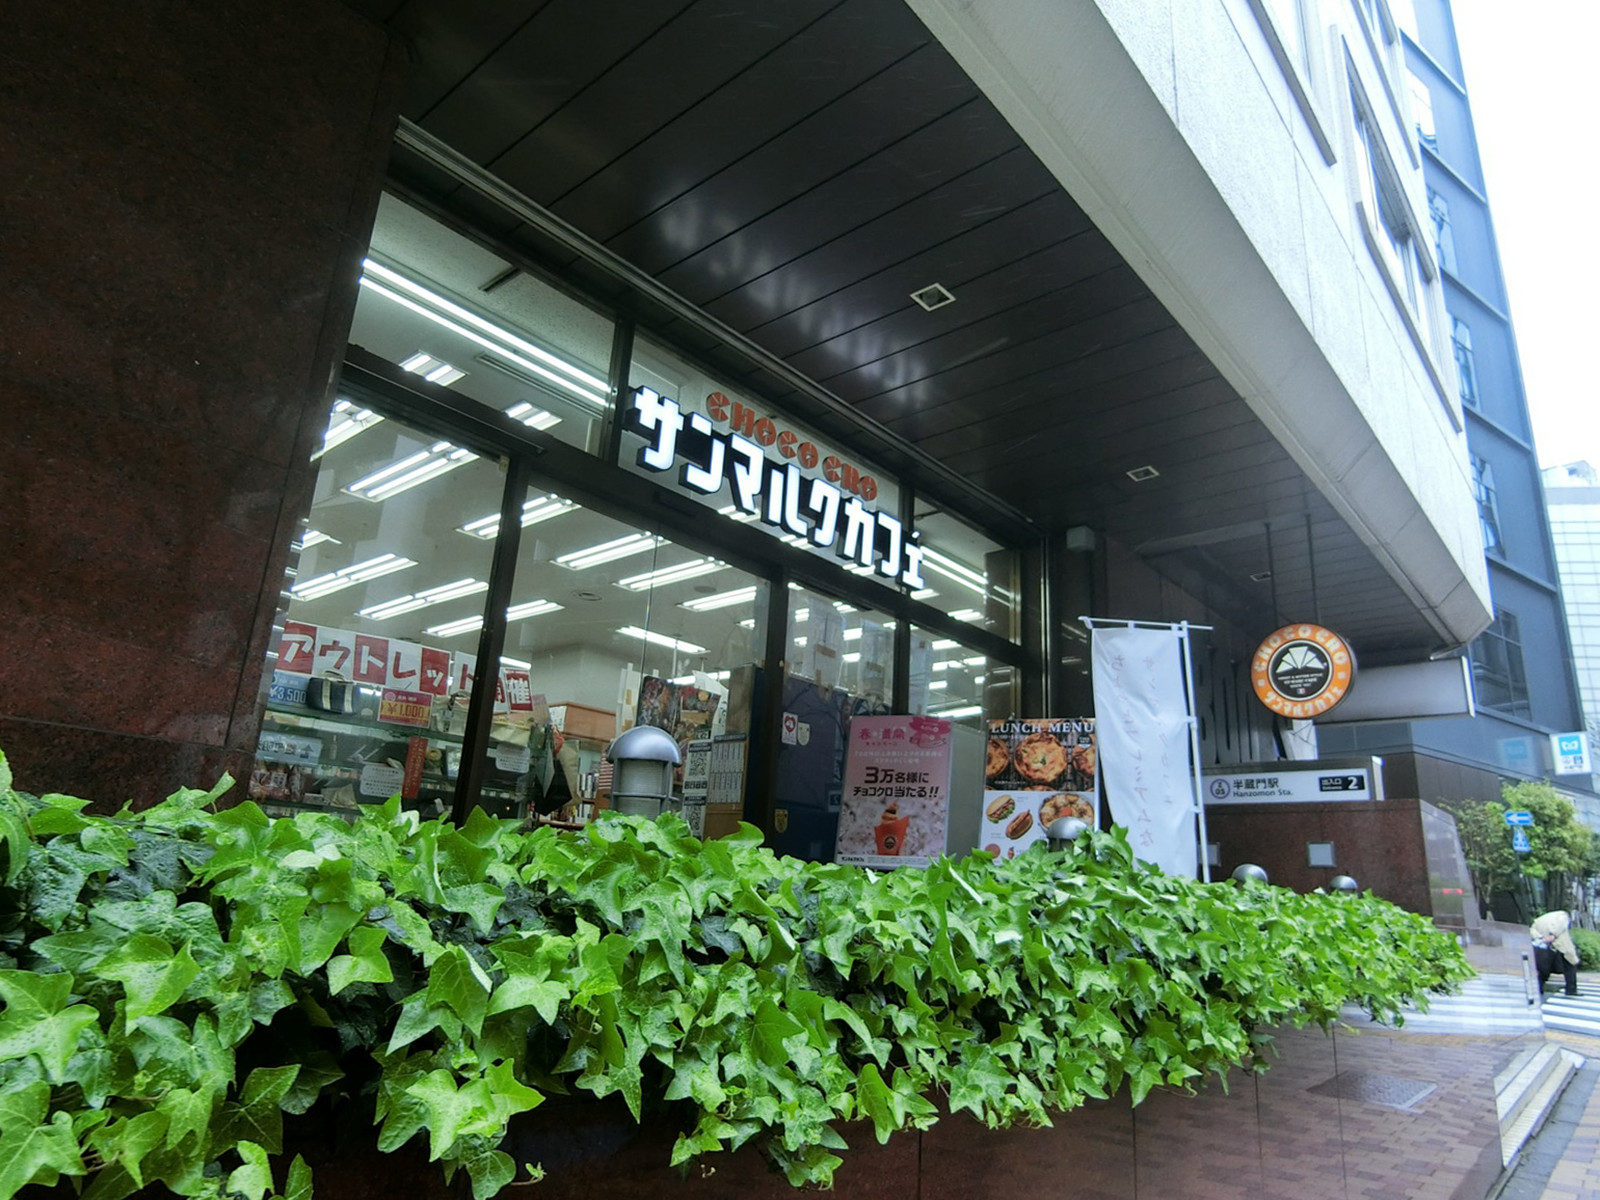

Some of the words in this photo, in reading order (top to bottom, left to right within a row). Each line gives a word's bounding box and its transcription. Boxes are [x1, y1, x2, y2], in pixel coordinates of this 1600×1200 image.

[706, 391, 819, 469] CHOCO
[822, 455, 878, 501] CRO
[634, 385, 925, 589] サンマルクカフェ
[1253, 625, 1312, 672] CHOCO
[1315, 629, 1347, 665] CRO
[991, 722, 1042, 733] LUNCH
[1048, 722, 1095, 733] MENU
[864, 766, 930, 784] 3万名様に
[1347, 776, 1359, 790] 2
[1233, 777, 1279, 790] 半蔵門駅
[1233, 790, 1276, 798] Hanzomon
[1278, 788, 1293, 796] Sta.
